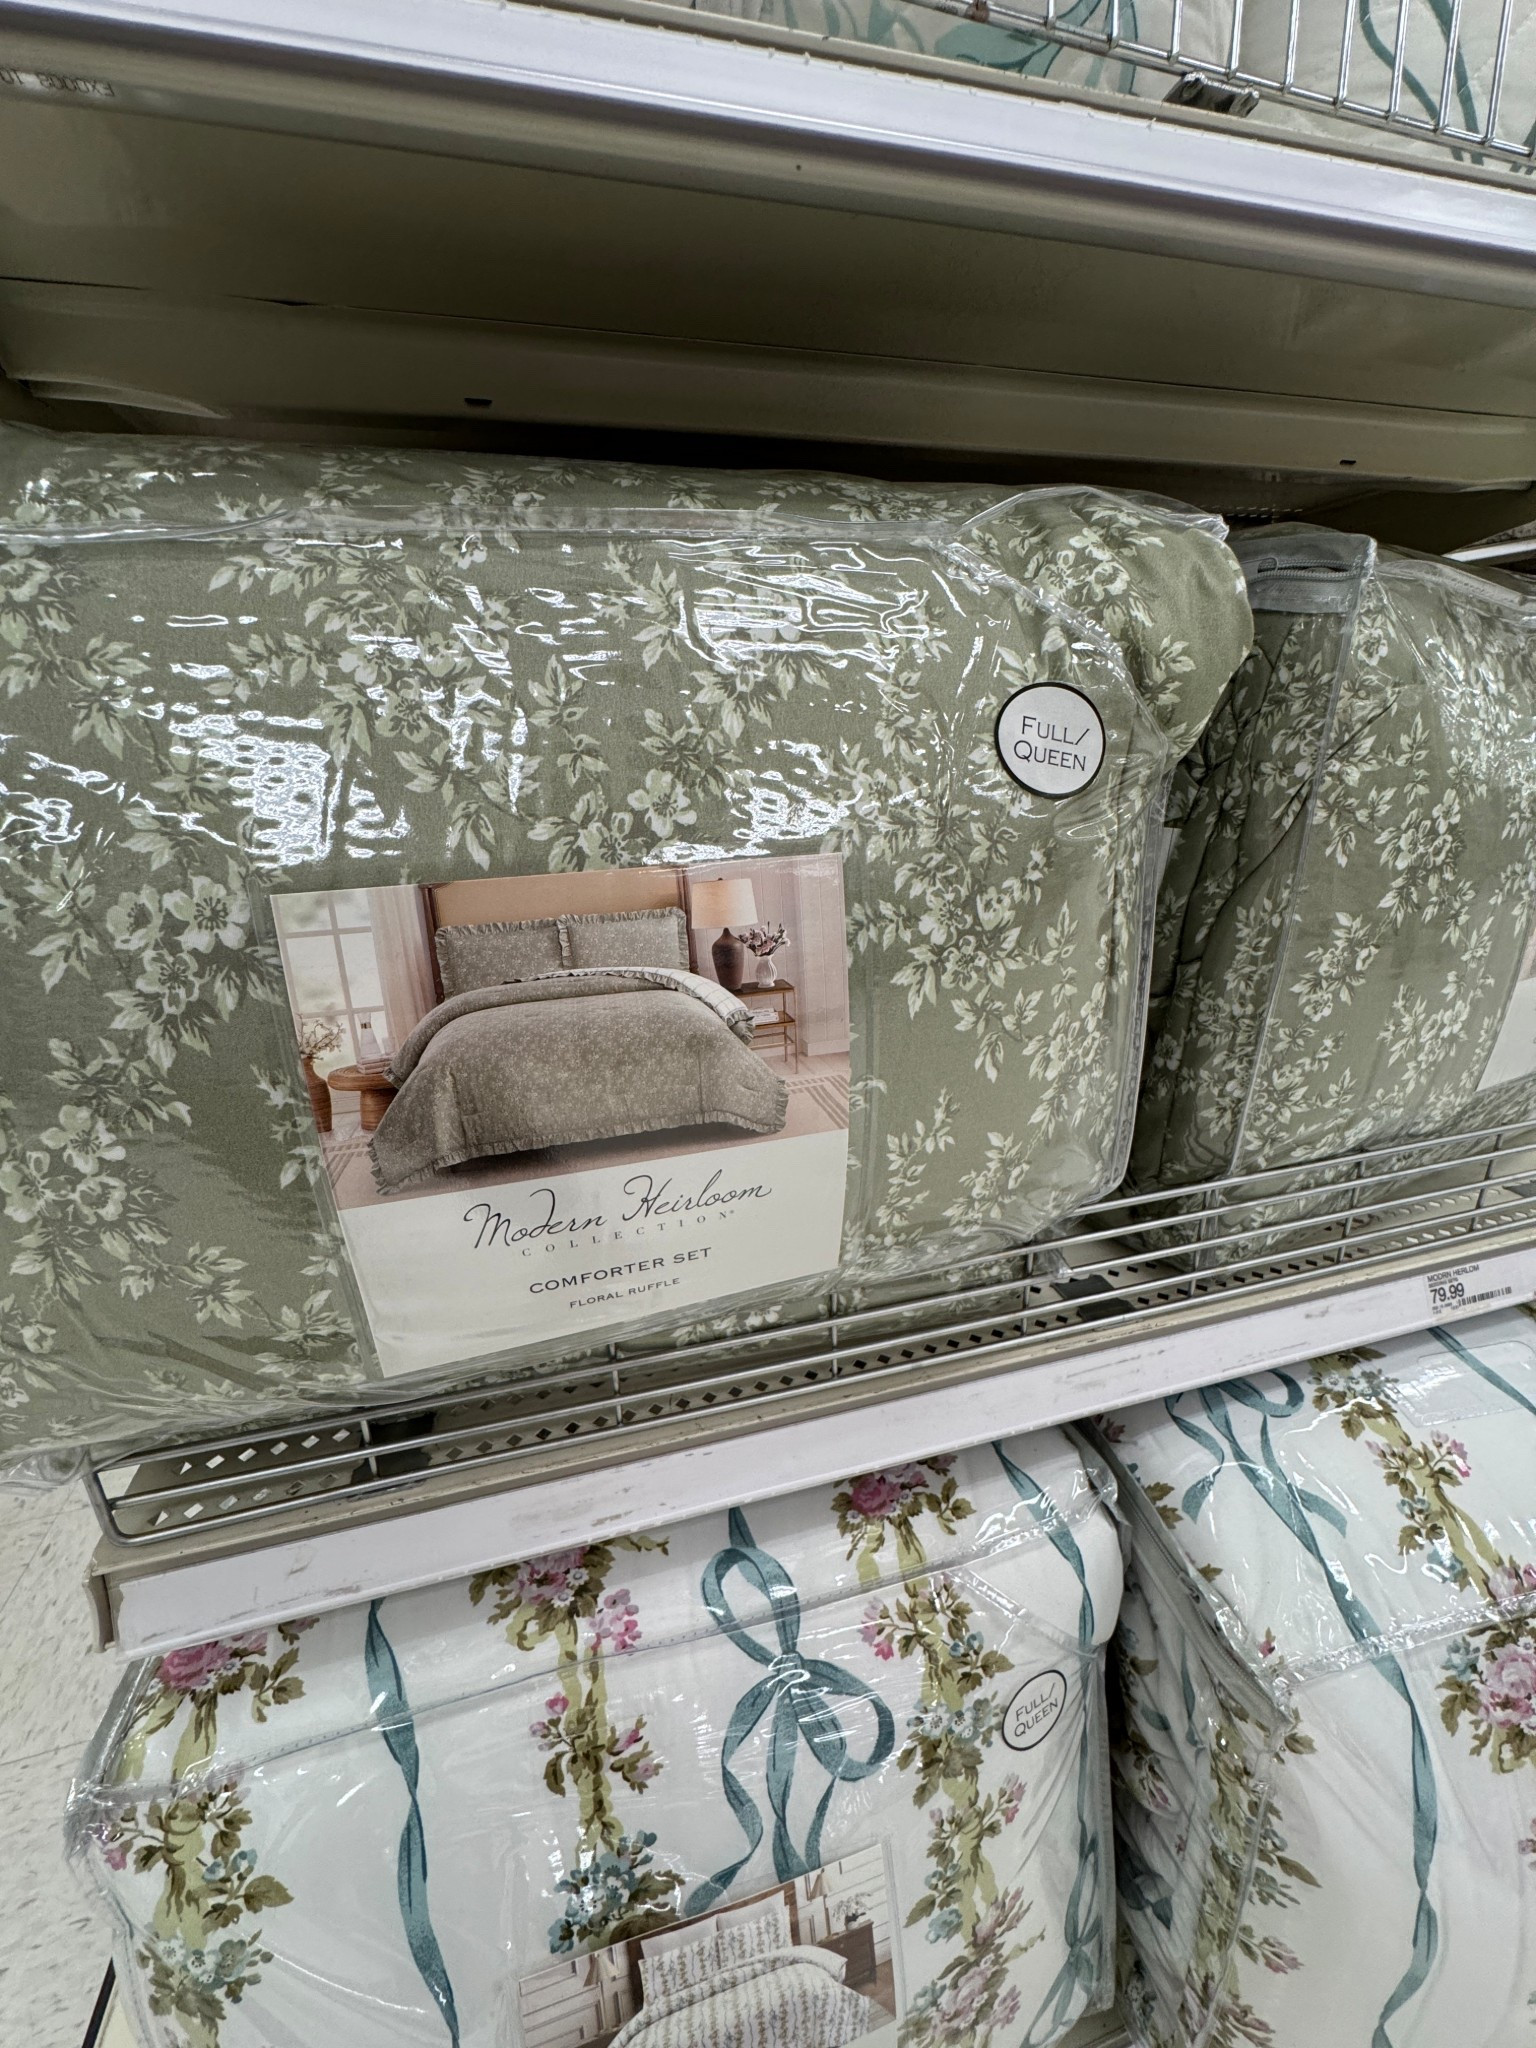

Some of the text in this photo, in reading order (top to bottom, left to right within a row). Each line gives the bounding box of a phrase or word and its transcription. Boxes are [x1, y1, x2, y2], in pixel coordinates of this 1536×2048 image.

[1021, 715, 1090, 746] FULL/
[1013, 740, 1087, 772] QUEEN
[463, 1168, 773, 1249] Modern Heirloom
[529, 1246, 713, 1294] COMFORTER SET
[1427, 1271, 1452, 1282] MODRN
[569, 1277, 681, 1309] FLORAL RUFFLE
[1430, 1282, 1465, 1304] 79.99
[1014, 1697, 1059, 1737] QUEEN
[1015, 1682, 1056, 1722] FULL/
